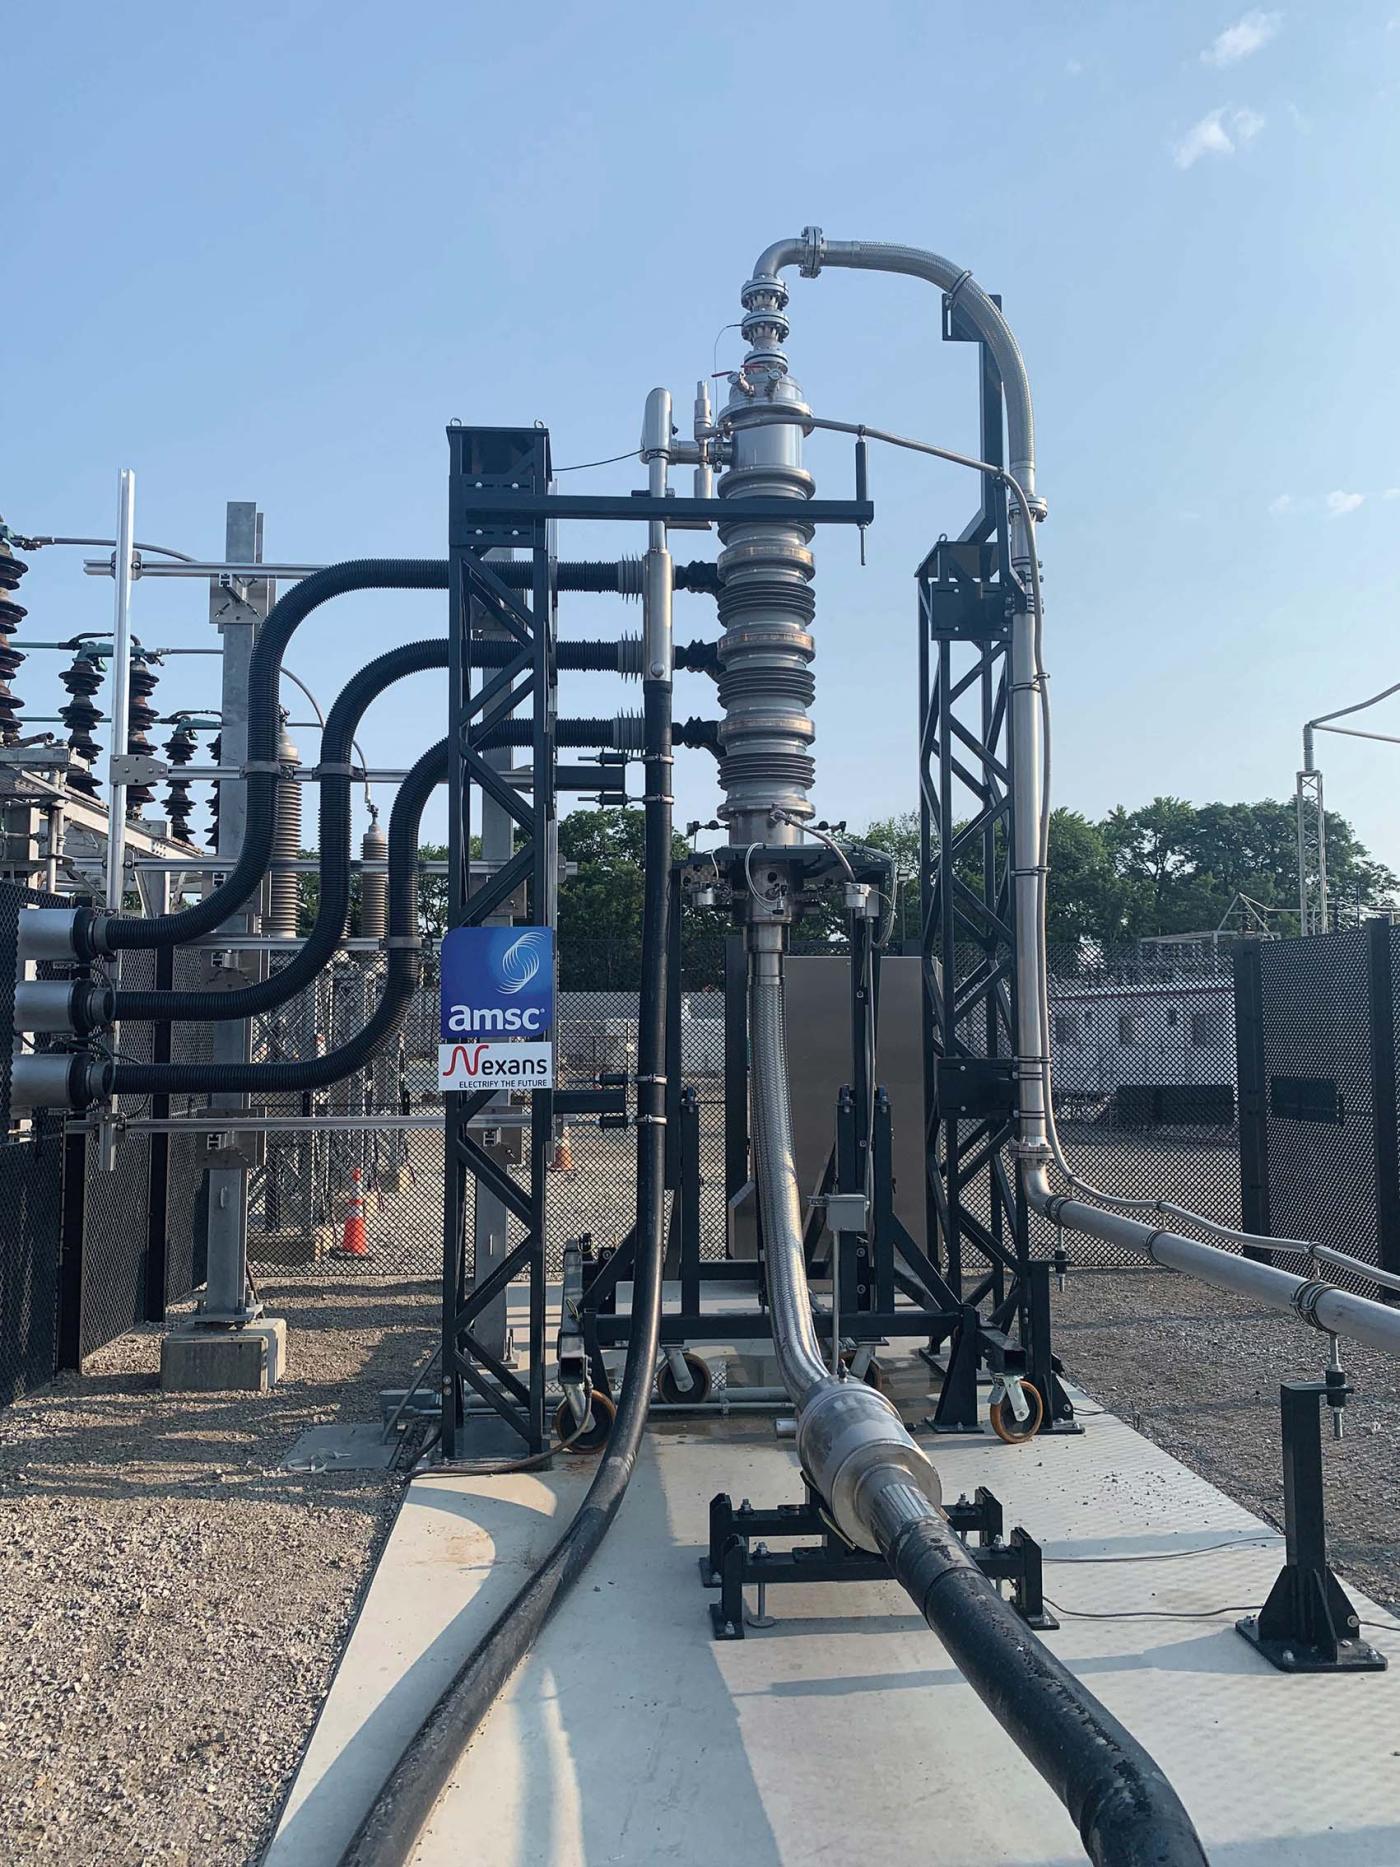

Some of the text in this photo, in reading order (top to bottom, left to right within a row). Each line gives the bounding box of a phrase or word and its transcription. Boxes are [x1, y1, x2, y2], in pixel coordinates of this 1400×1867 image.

[448, 1004, 540, 1032] amsc
[442, 1045, 548, 1077] Nexans
[459, 1079, 548, 1089] ELECTRIFY THE FUTURE
